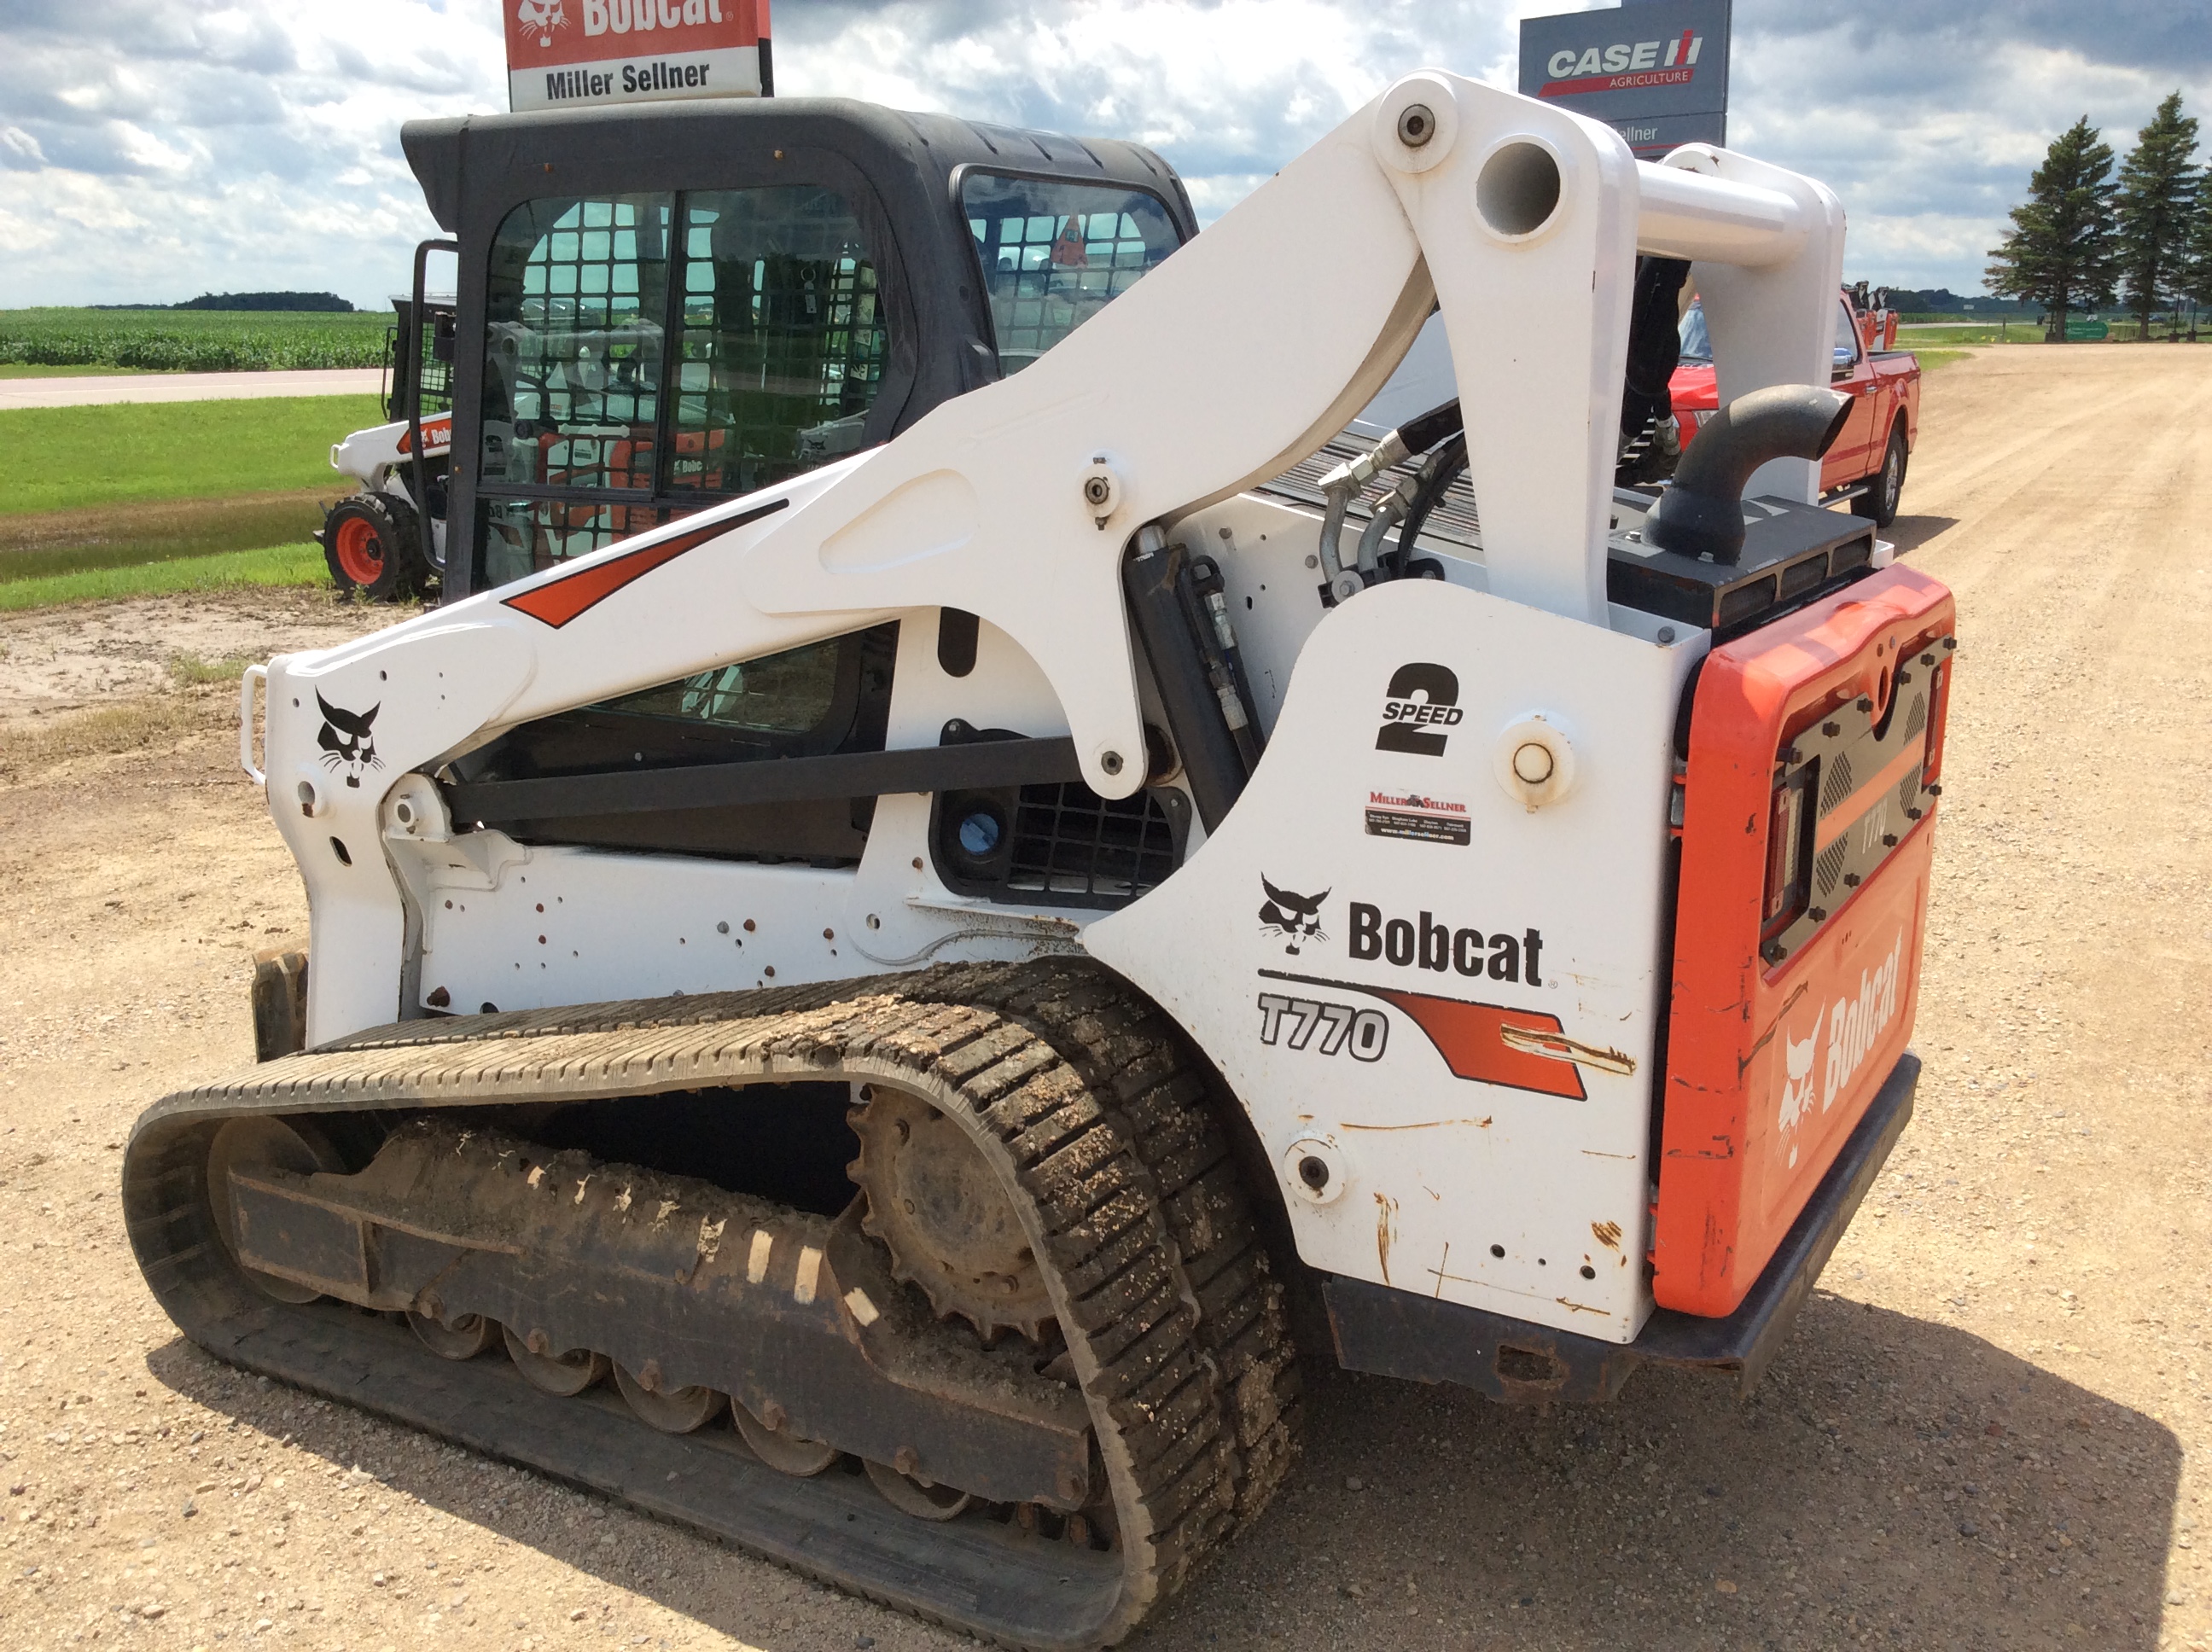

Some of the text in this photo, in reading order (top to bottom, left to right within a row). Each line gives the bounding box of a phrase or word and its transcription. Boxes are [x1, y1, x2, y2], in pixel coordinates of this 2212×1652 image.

[582, 0, 723, 37] Bobcat
[1547, 41, 1661, 79] CASE
[1610, 71, 1689, 88] AGRICULTURE
[546, 61, 710, 101] Miller Sellner
[431, 427, 451, 445] Bob
[1375, 662, 1459, 758] 2
[1382, 701, 1464, 726] SPEED
[1370, 791, 1467, 812] MILLER SELLNER
[1862, 797, 1888, 855] T770
[1348, 901, 1544, 987] Bobcat
[1258, 992, 1389, 1063] T770
[1822, 924, 1903, 1115] Bobcat
